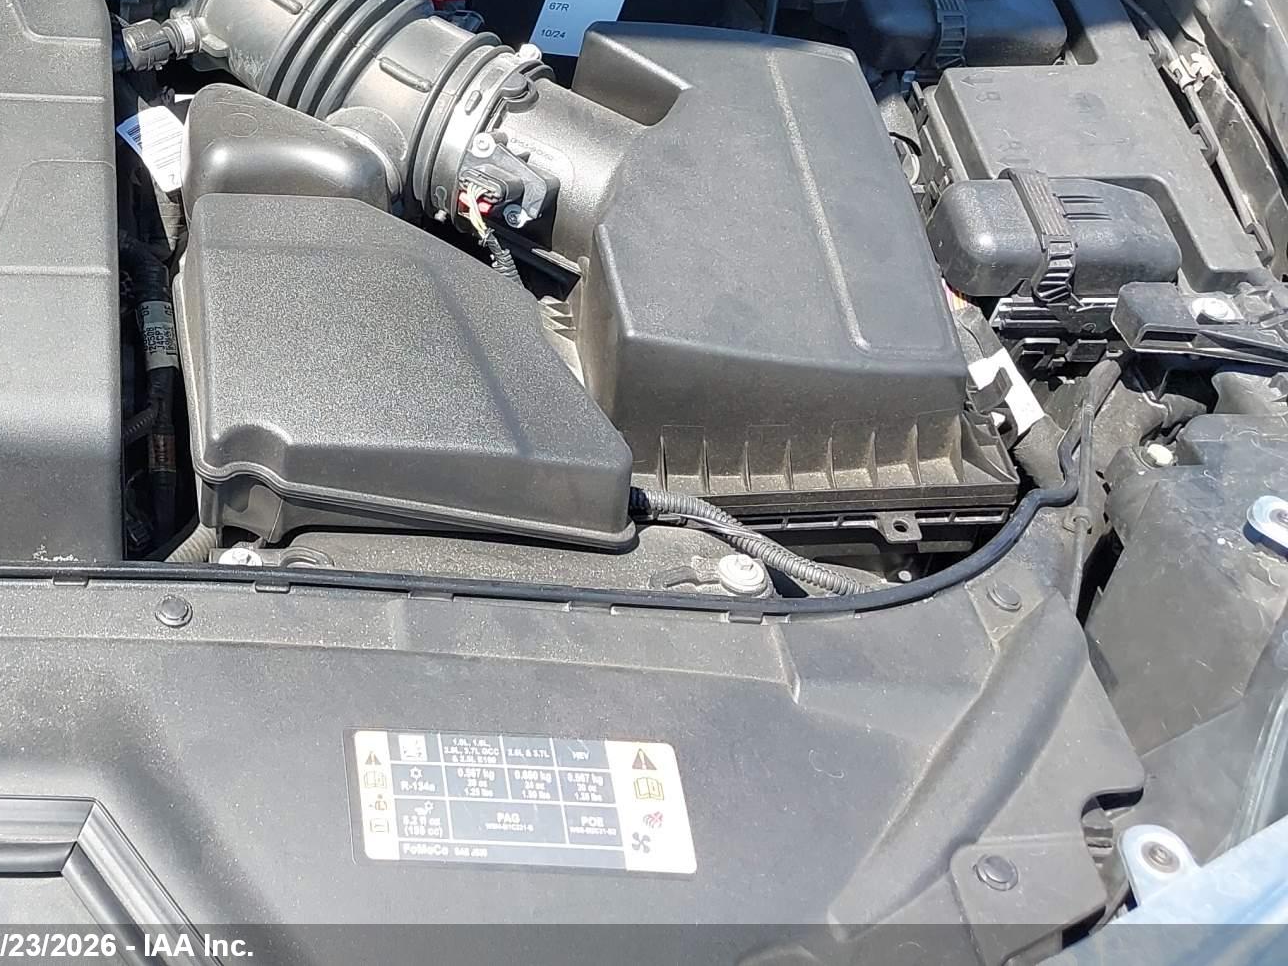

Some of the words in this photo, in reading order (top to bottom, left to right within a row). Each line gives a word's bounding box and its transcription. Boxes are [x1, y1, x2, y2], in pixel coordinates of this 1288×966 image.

[549, 2, 569, 12] 67R
[541, 28, 566, 39] 10/24
[483, 768, 495, 781] kg
[540, 770, 552, 783] kg
[591, 773, 604, 786] kg
[429, 817, 441, 826] oz
[496, 811, 521, 824] PAG
[403, 843, 449, 856] FoMoCo
